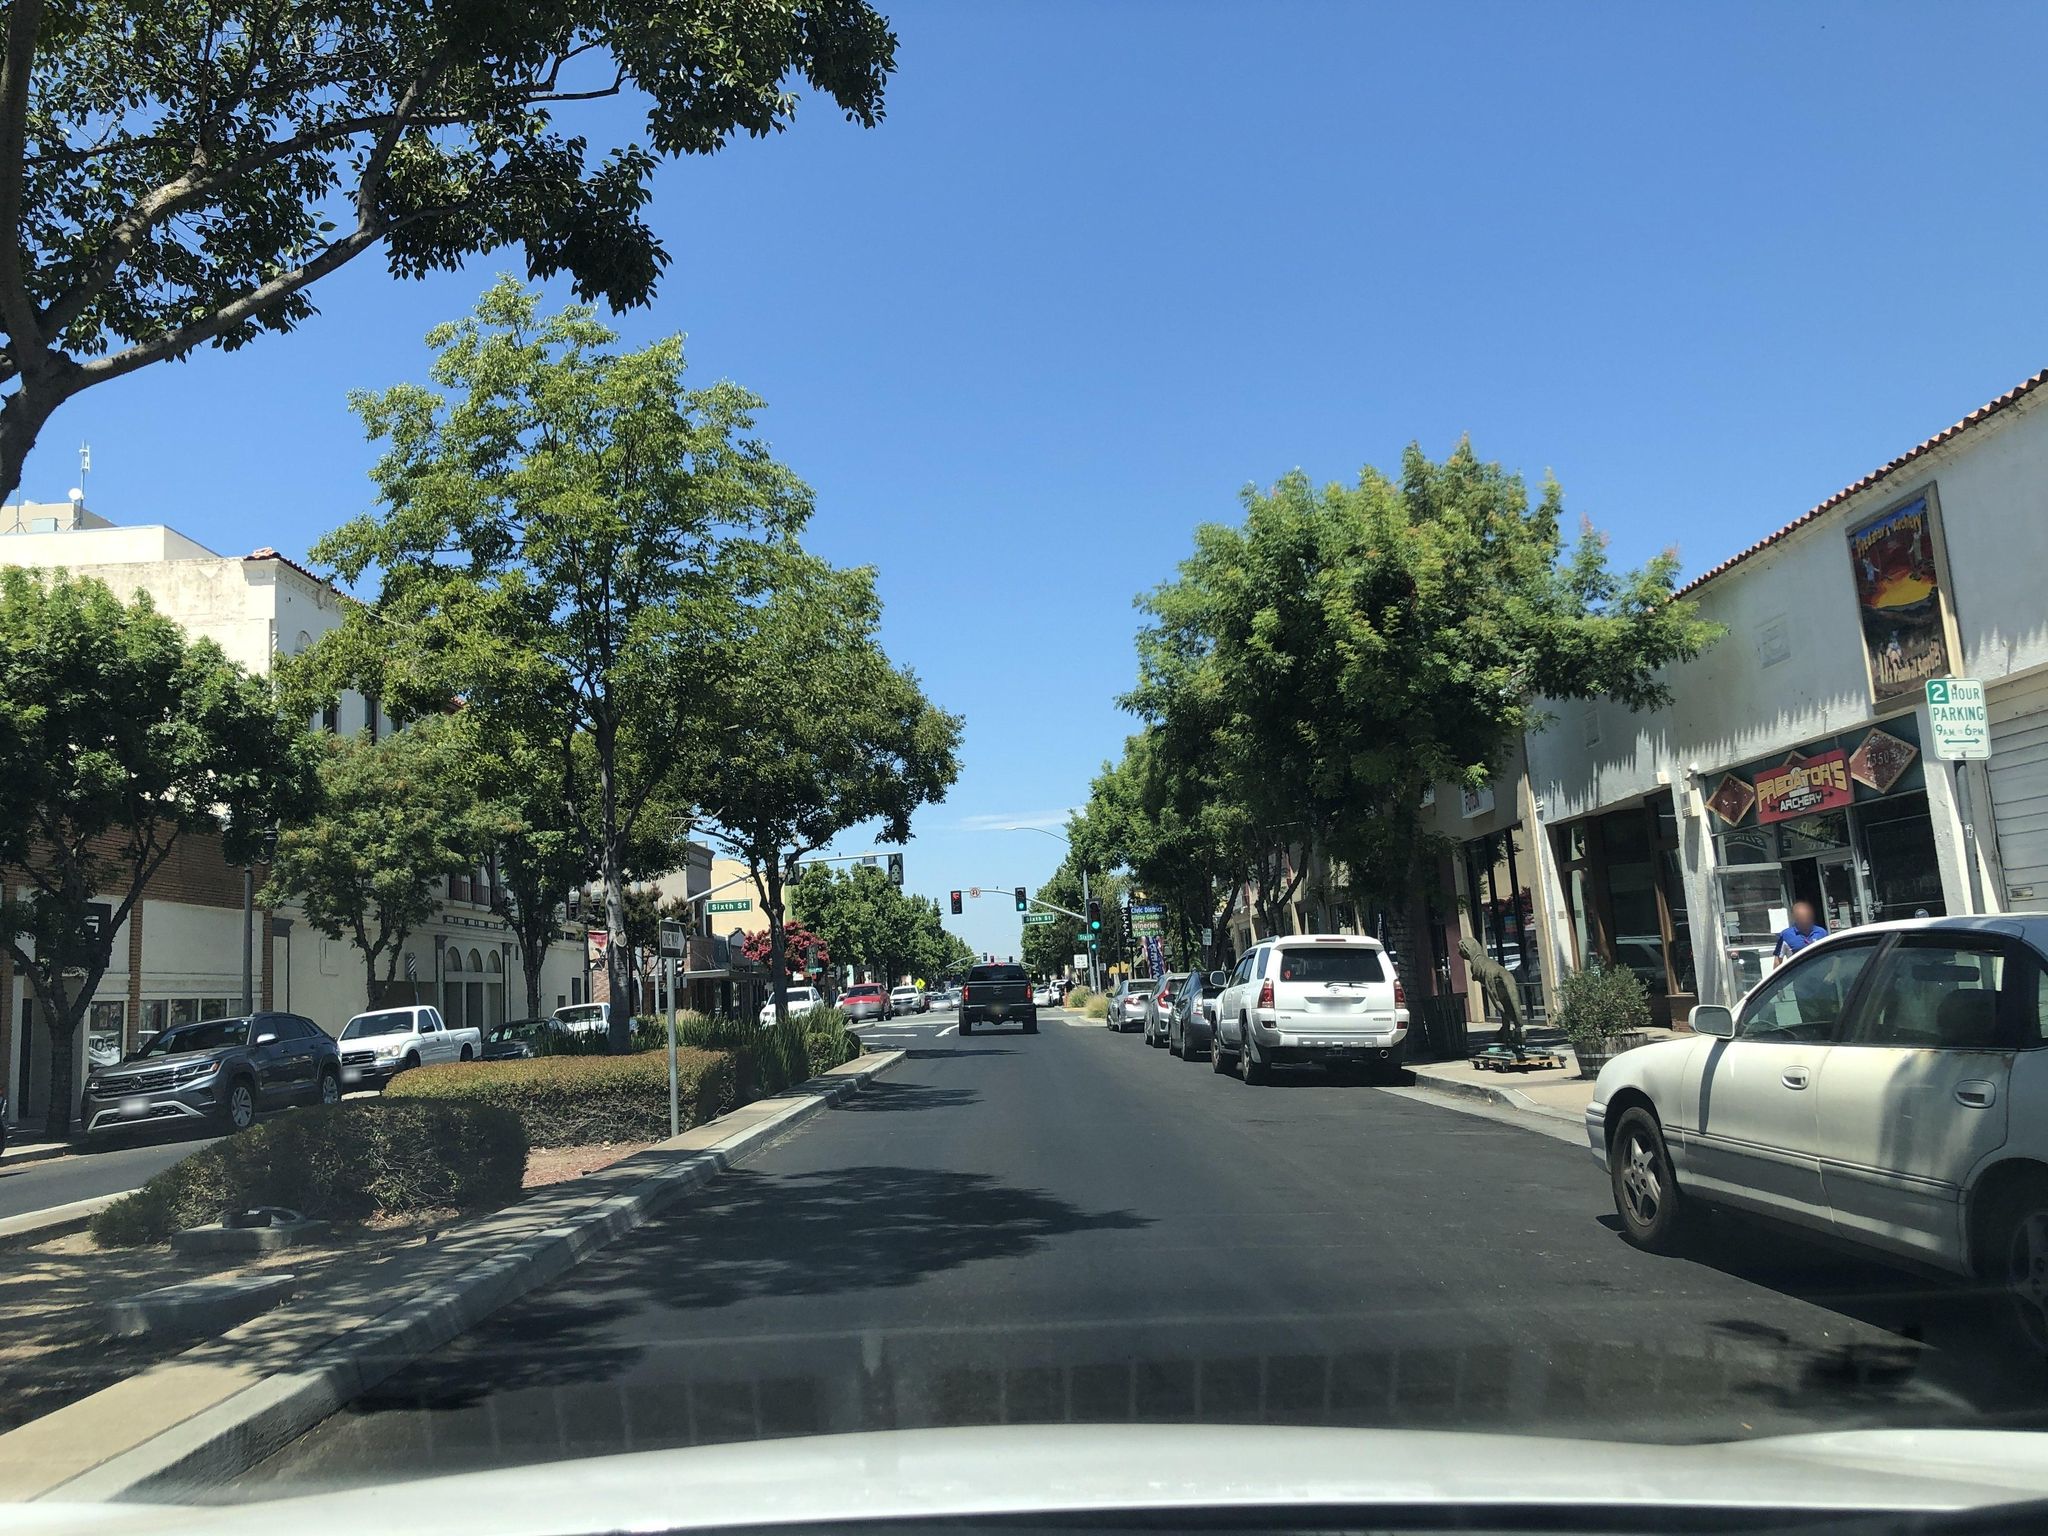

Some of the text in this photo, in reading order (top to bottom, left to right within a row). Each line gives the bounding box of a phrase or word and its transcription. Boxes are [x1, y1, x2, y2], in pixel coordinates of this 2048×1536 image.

[1931, 683, 1980, 701] 2 HOUR
[1932, 706, 1984, 721] PARKING
[1757, 760, 1848, 812] PREDATOR'S
[1780, 792, 1822, 812] ARCHERY
[711, 903, 734, 911] Sixth
[1131, 921, 1158, 929] Wineries
[662, 932, 680, 948] ONE WAY
